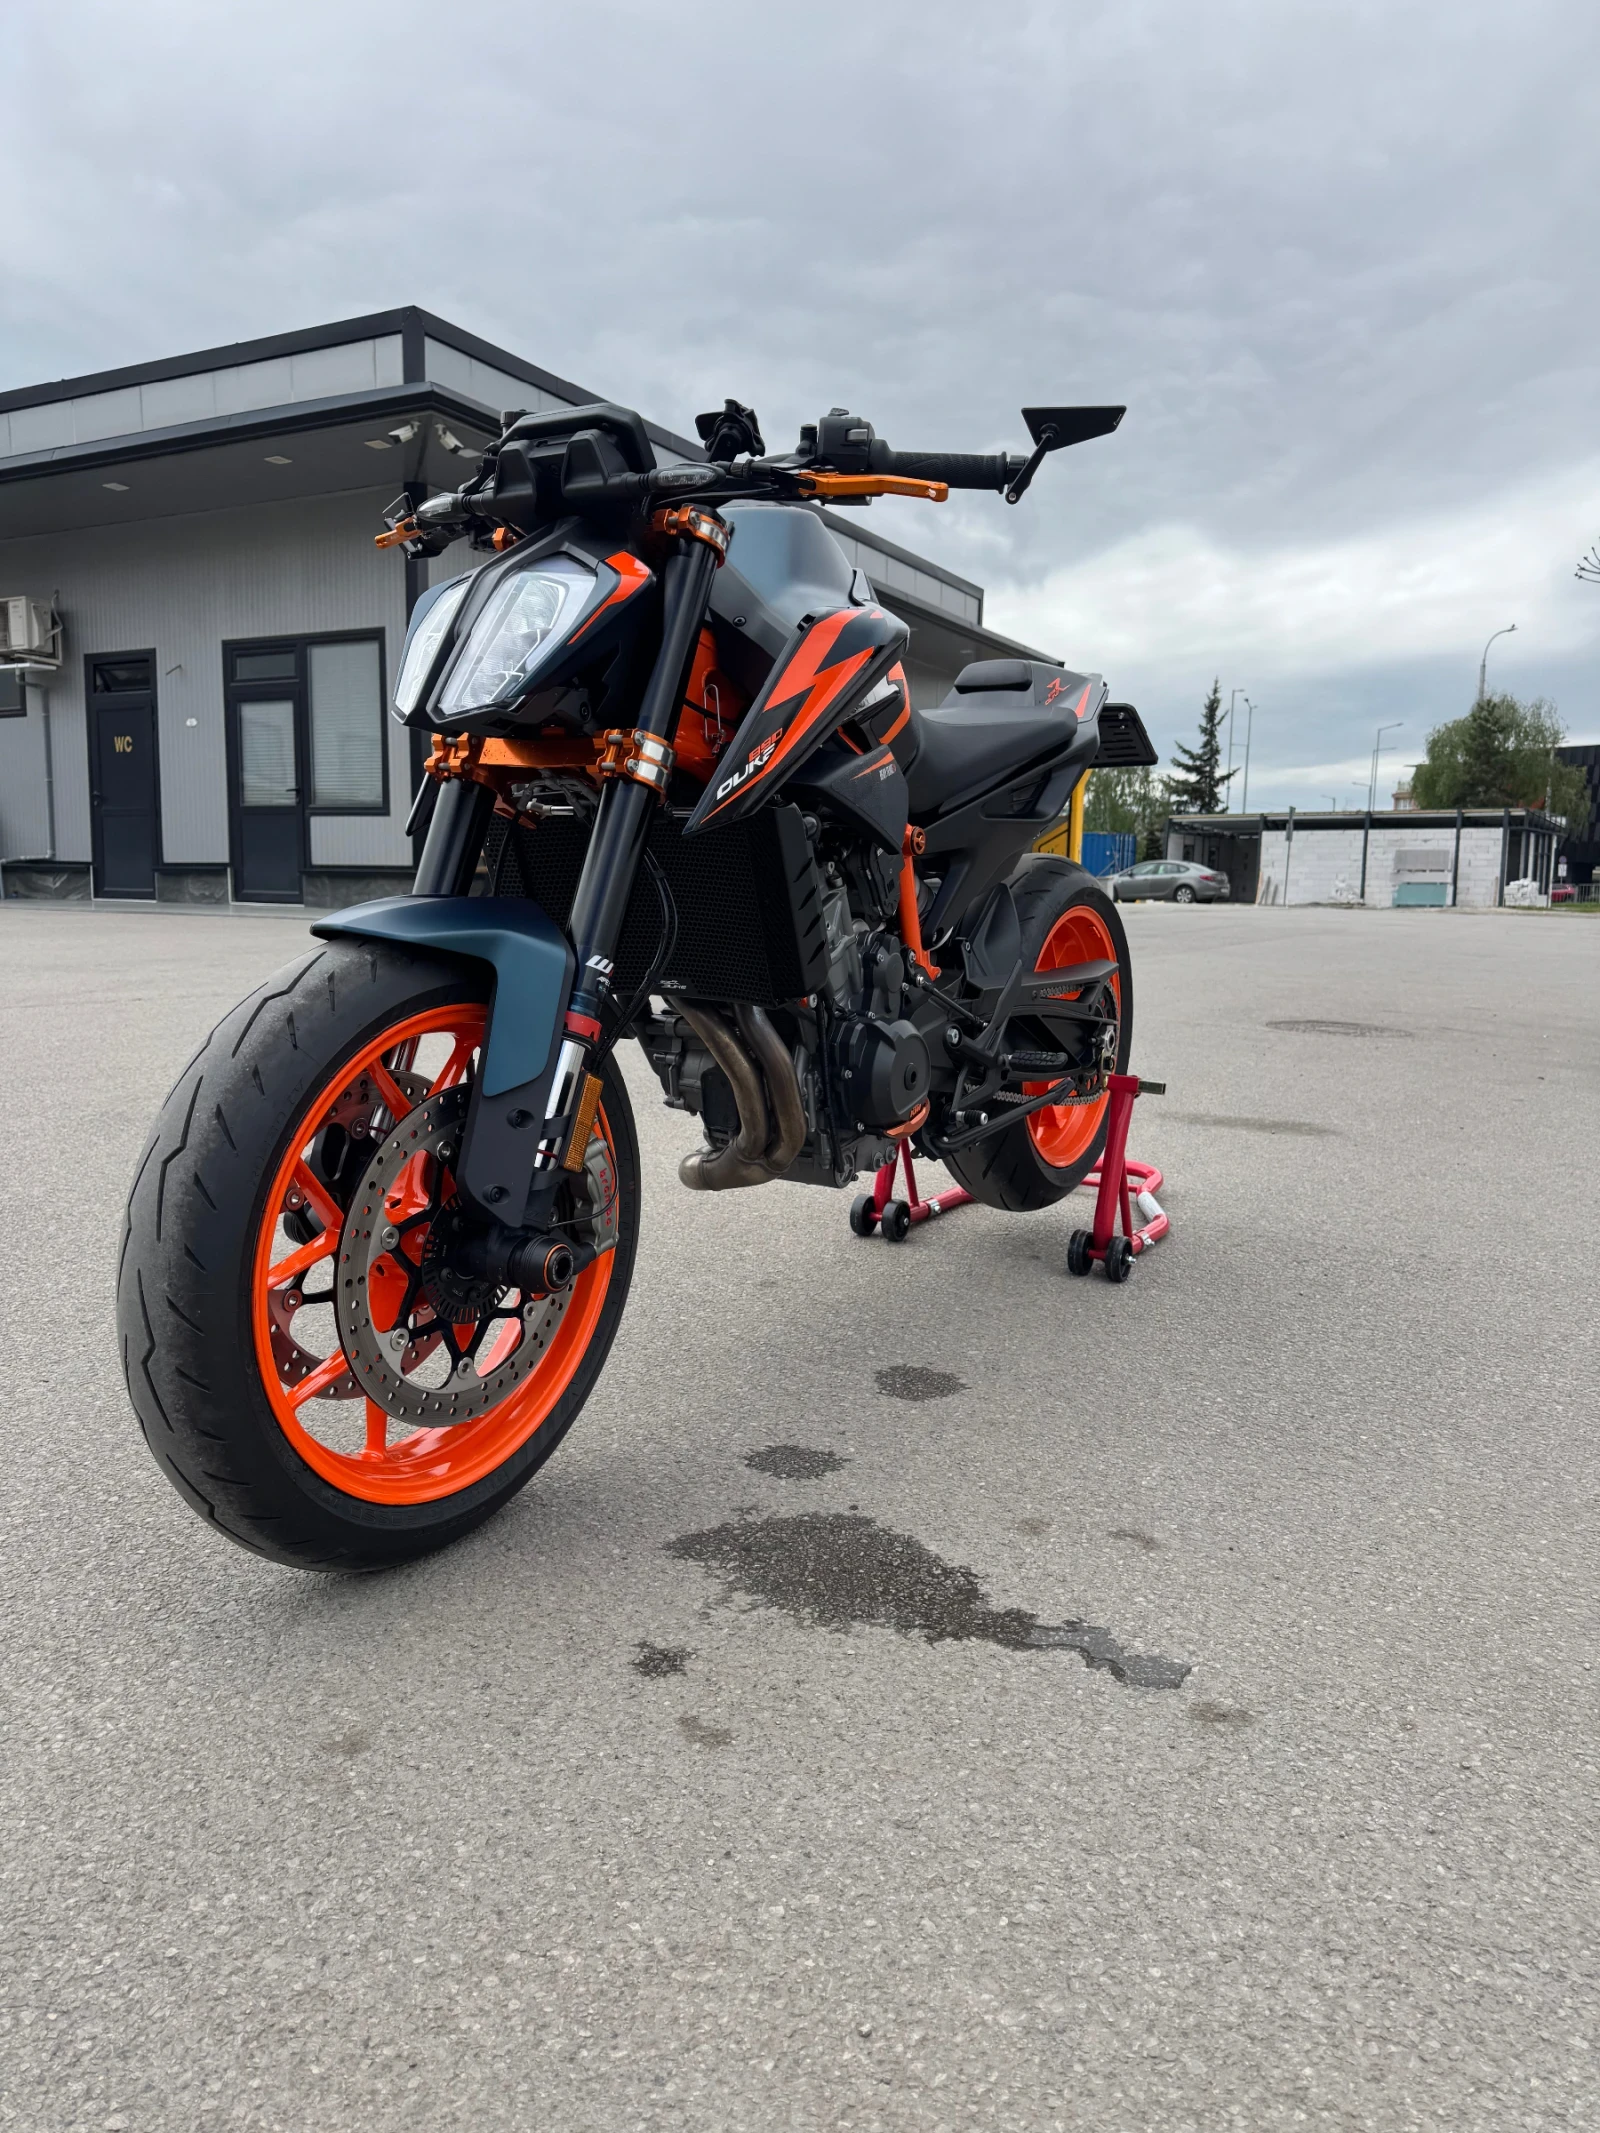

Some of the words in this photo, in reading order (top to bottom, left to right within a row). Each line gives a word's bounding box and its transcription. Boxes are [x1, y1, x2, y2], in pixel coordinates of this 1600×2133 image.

[114, 735, 133, 753] WC
[749, 727, 782, 762] 890
[716, 743, 776, 800] DUKE
